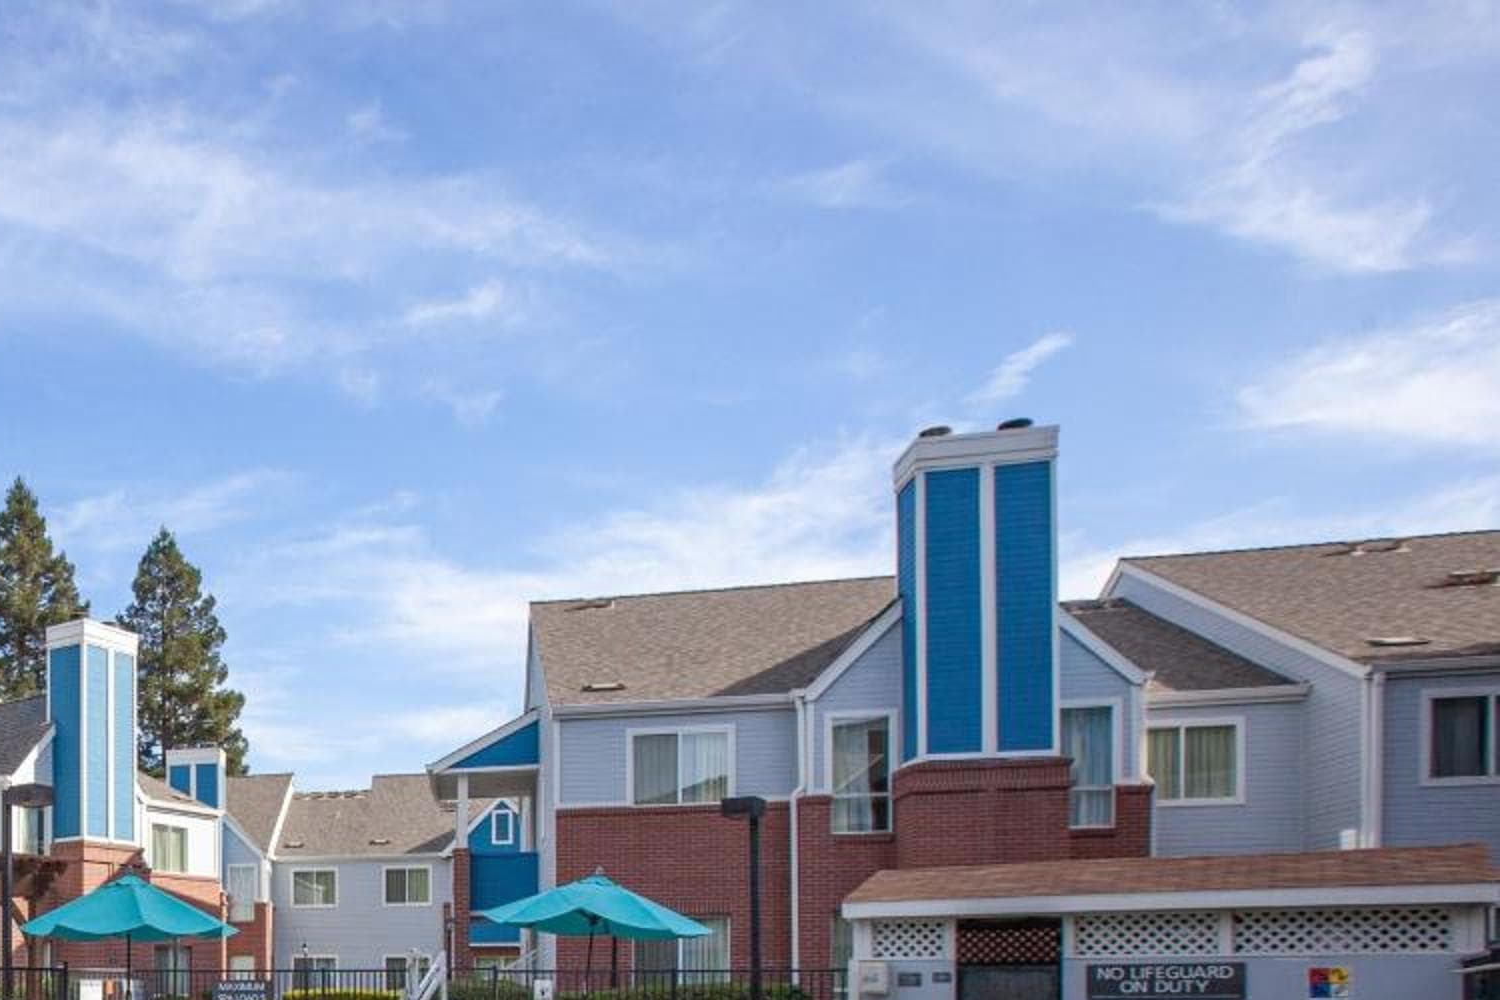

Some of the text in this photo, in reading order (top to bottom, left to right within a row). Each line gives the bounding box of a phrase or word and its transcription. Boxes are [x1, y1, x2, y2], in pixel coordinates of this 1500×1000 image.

[1096, 965, 1235, 980] NO LIFEGUARD
[1119, 980, 1210, 993] ON DUTY
